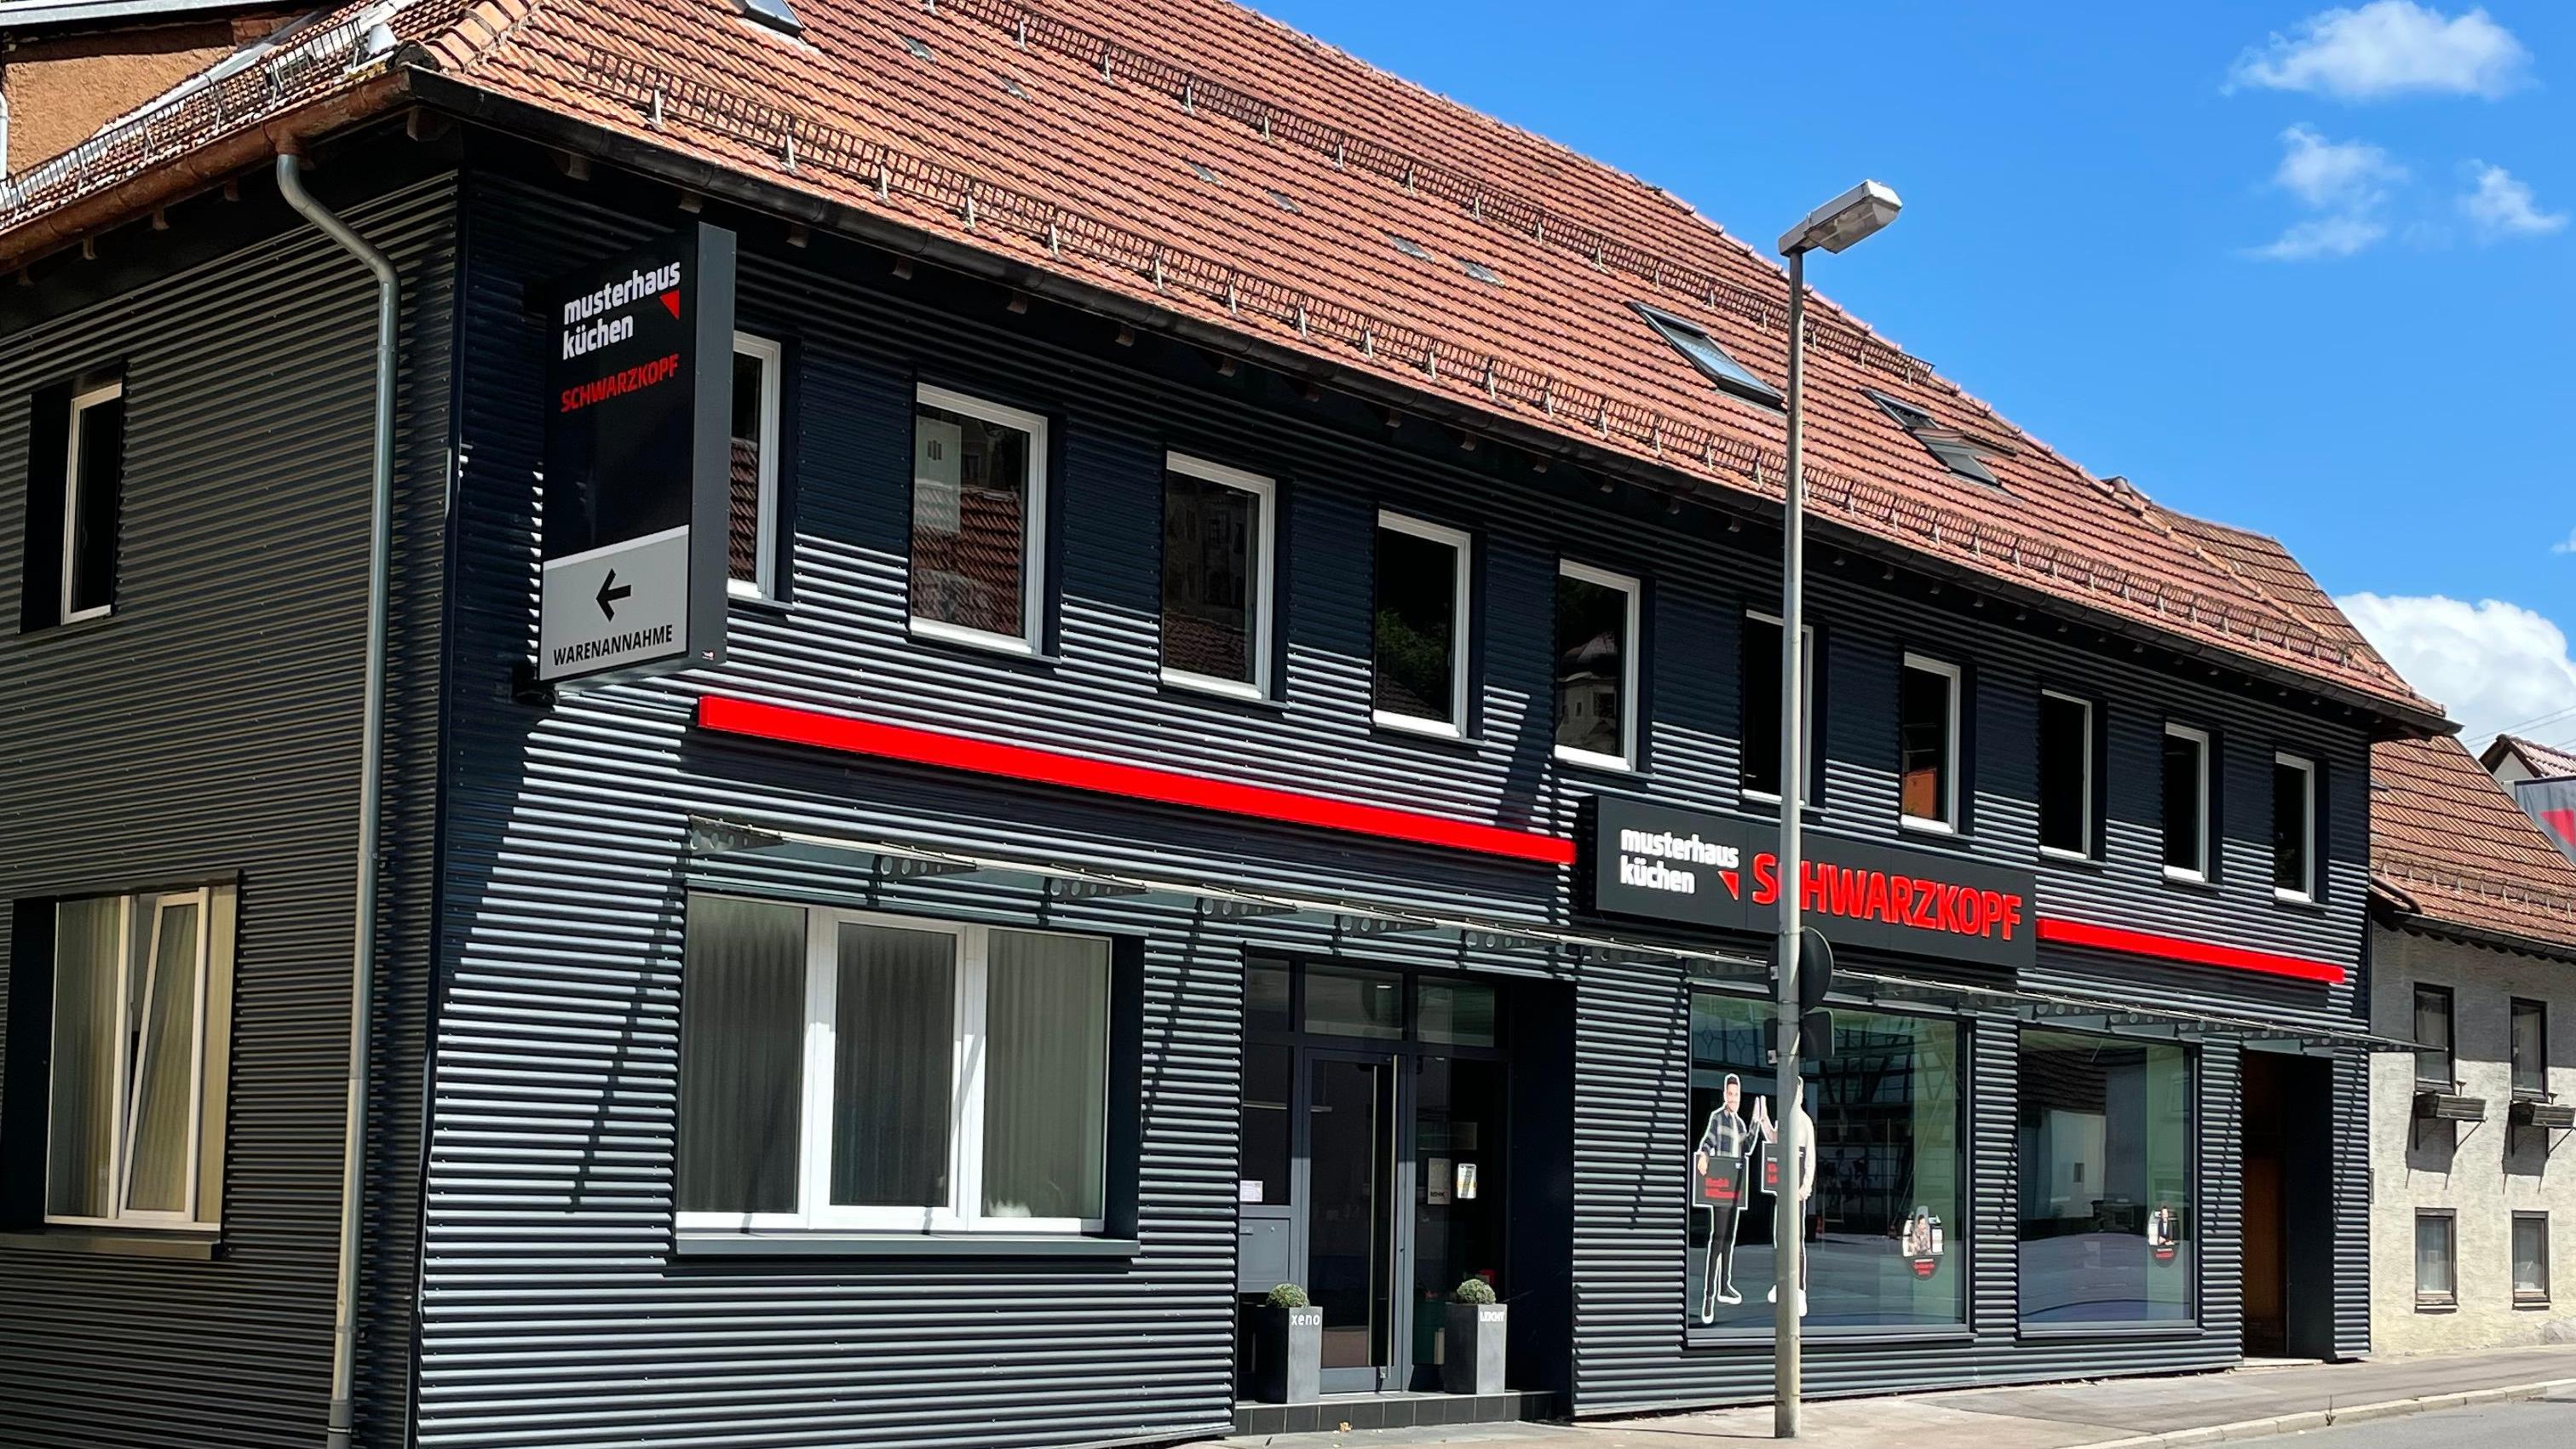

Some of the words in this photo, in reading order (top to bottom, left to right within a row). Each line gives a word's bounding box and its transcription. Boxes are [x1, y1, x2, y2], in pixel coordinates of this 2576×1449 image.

[564, 262, 681, 325] musterhaus
[563, 315, 634, 360] küchen
[561, 354, 679, 412] SCHWARZKOPF
[554, 624, 673, 666] WARENANNAHME
[1620, 829, 1739, 869] musterhaus
[1620, 854, 1695, 894] küchen
[1751, 853, 2022, 940] SHWARZKOPF
[1291, 1314, 1320, 1325] xeno
